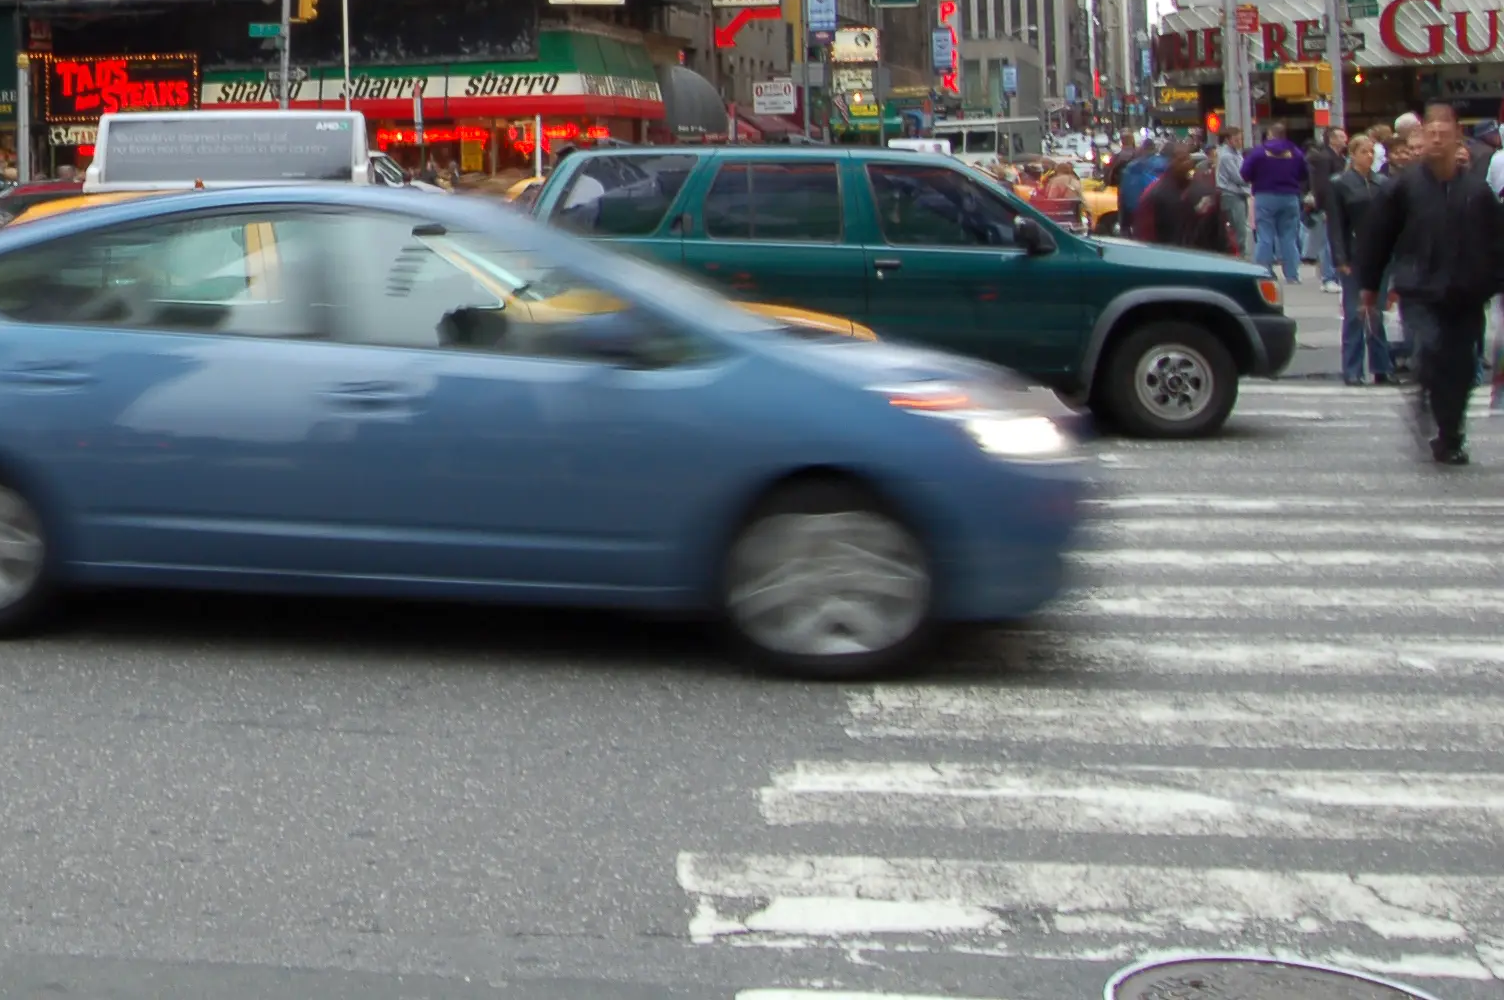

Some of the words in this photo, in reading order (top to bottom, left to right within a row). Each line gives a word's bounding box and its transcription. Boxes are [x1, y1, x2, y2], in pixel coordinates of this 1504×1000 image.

[101, 78, 189, 114] STEAKS
[465, 70, 560, 97] sbarro
[315, 121, 340, 131] AMD
